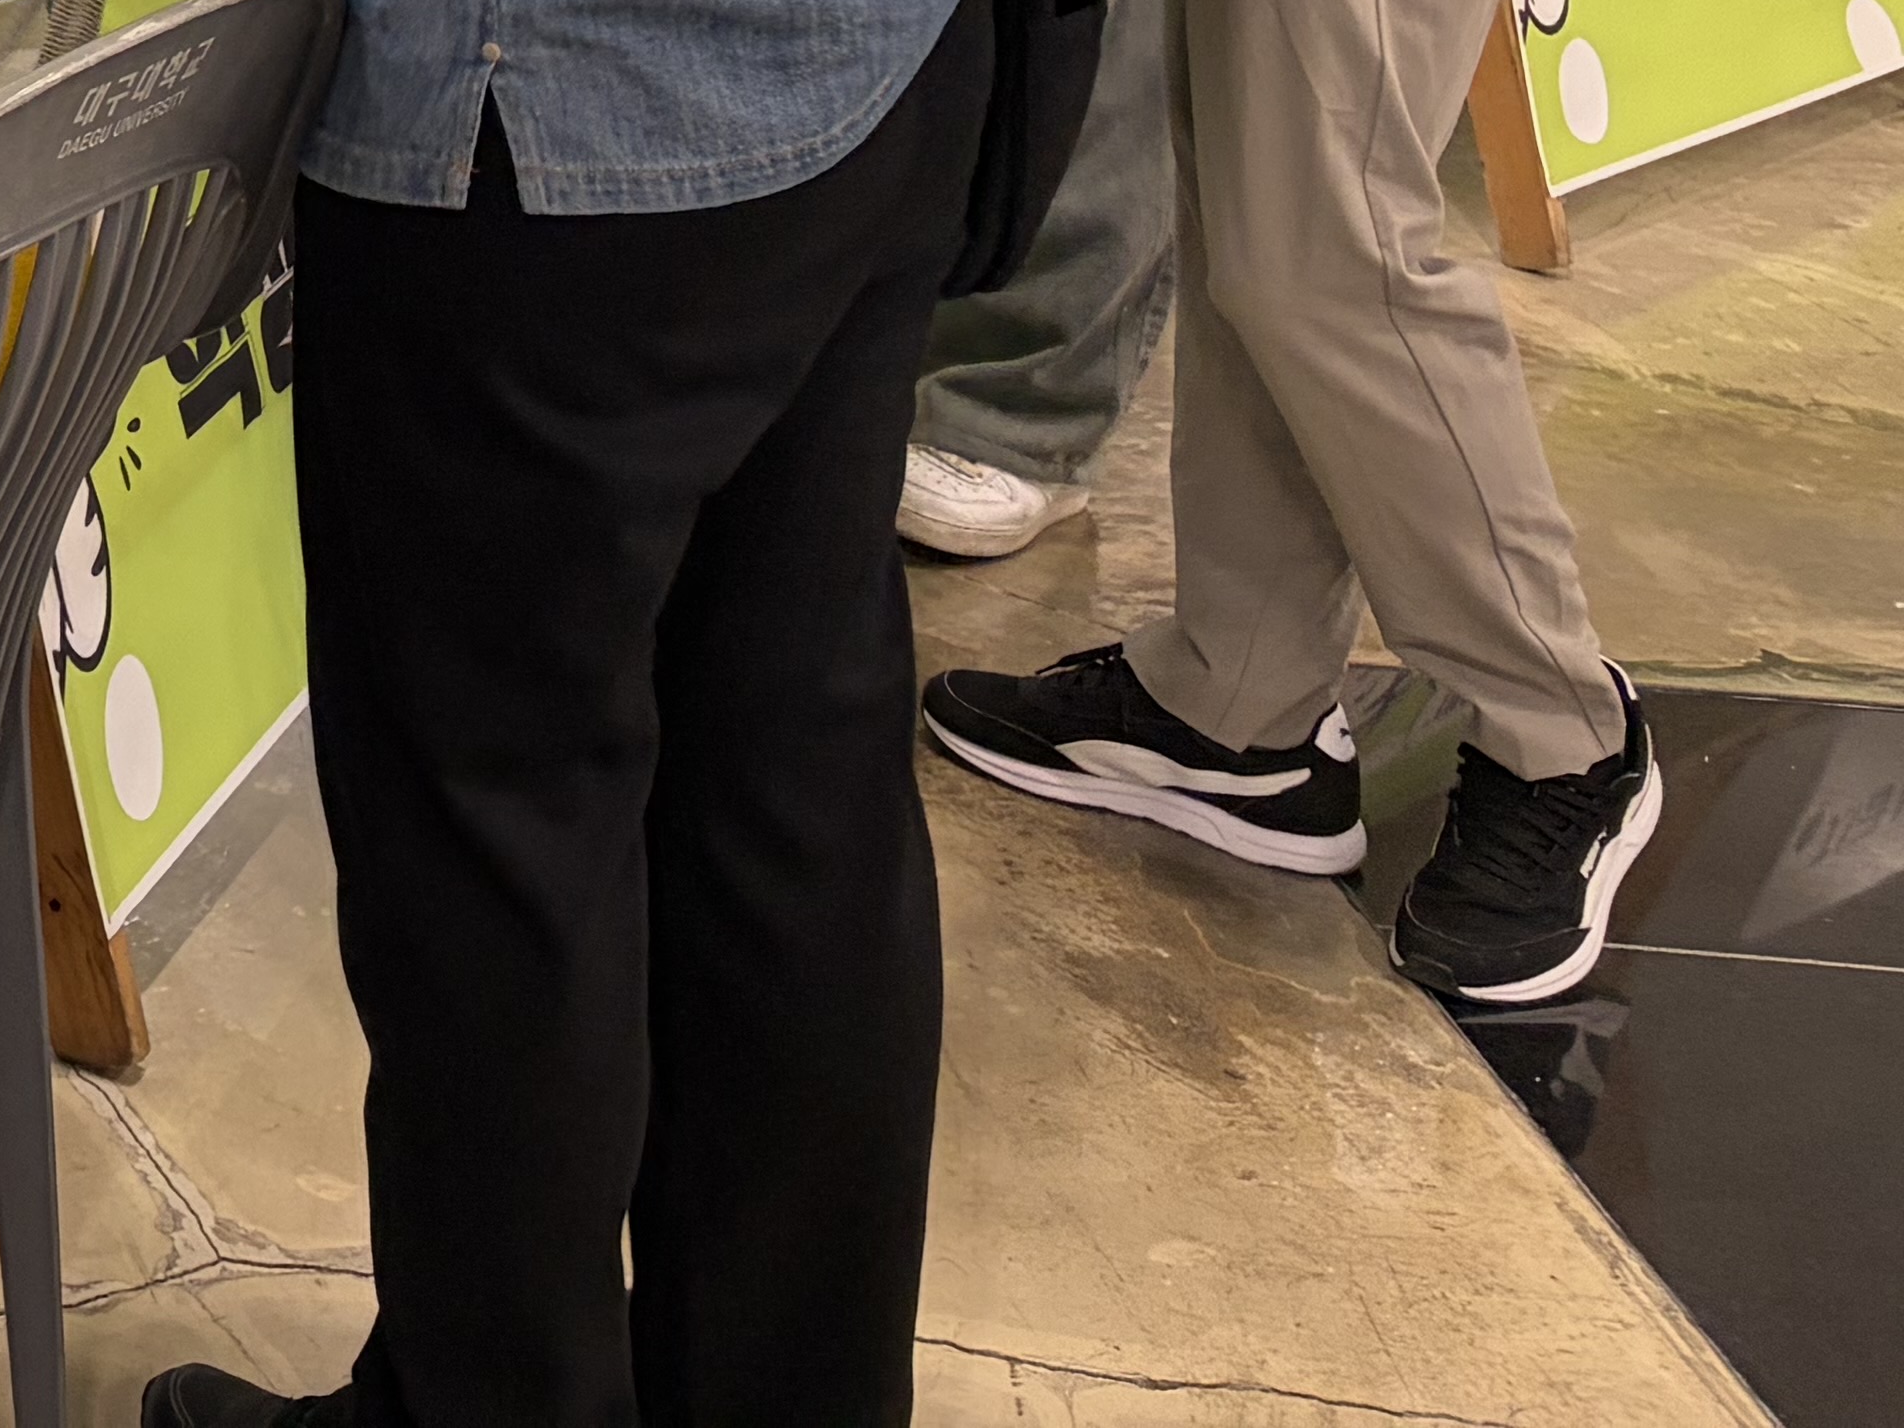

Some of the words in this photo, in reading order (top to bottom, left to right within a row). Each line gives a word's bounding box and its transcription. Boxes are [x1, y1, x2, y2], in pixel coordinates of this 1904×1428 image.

[57, 123, 113, 159] DAEGU
[113, 86, 190, 137] UNIVERSITY
[73, 36, 217, 127] 대구대학교
